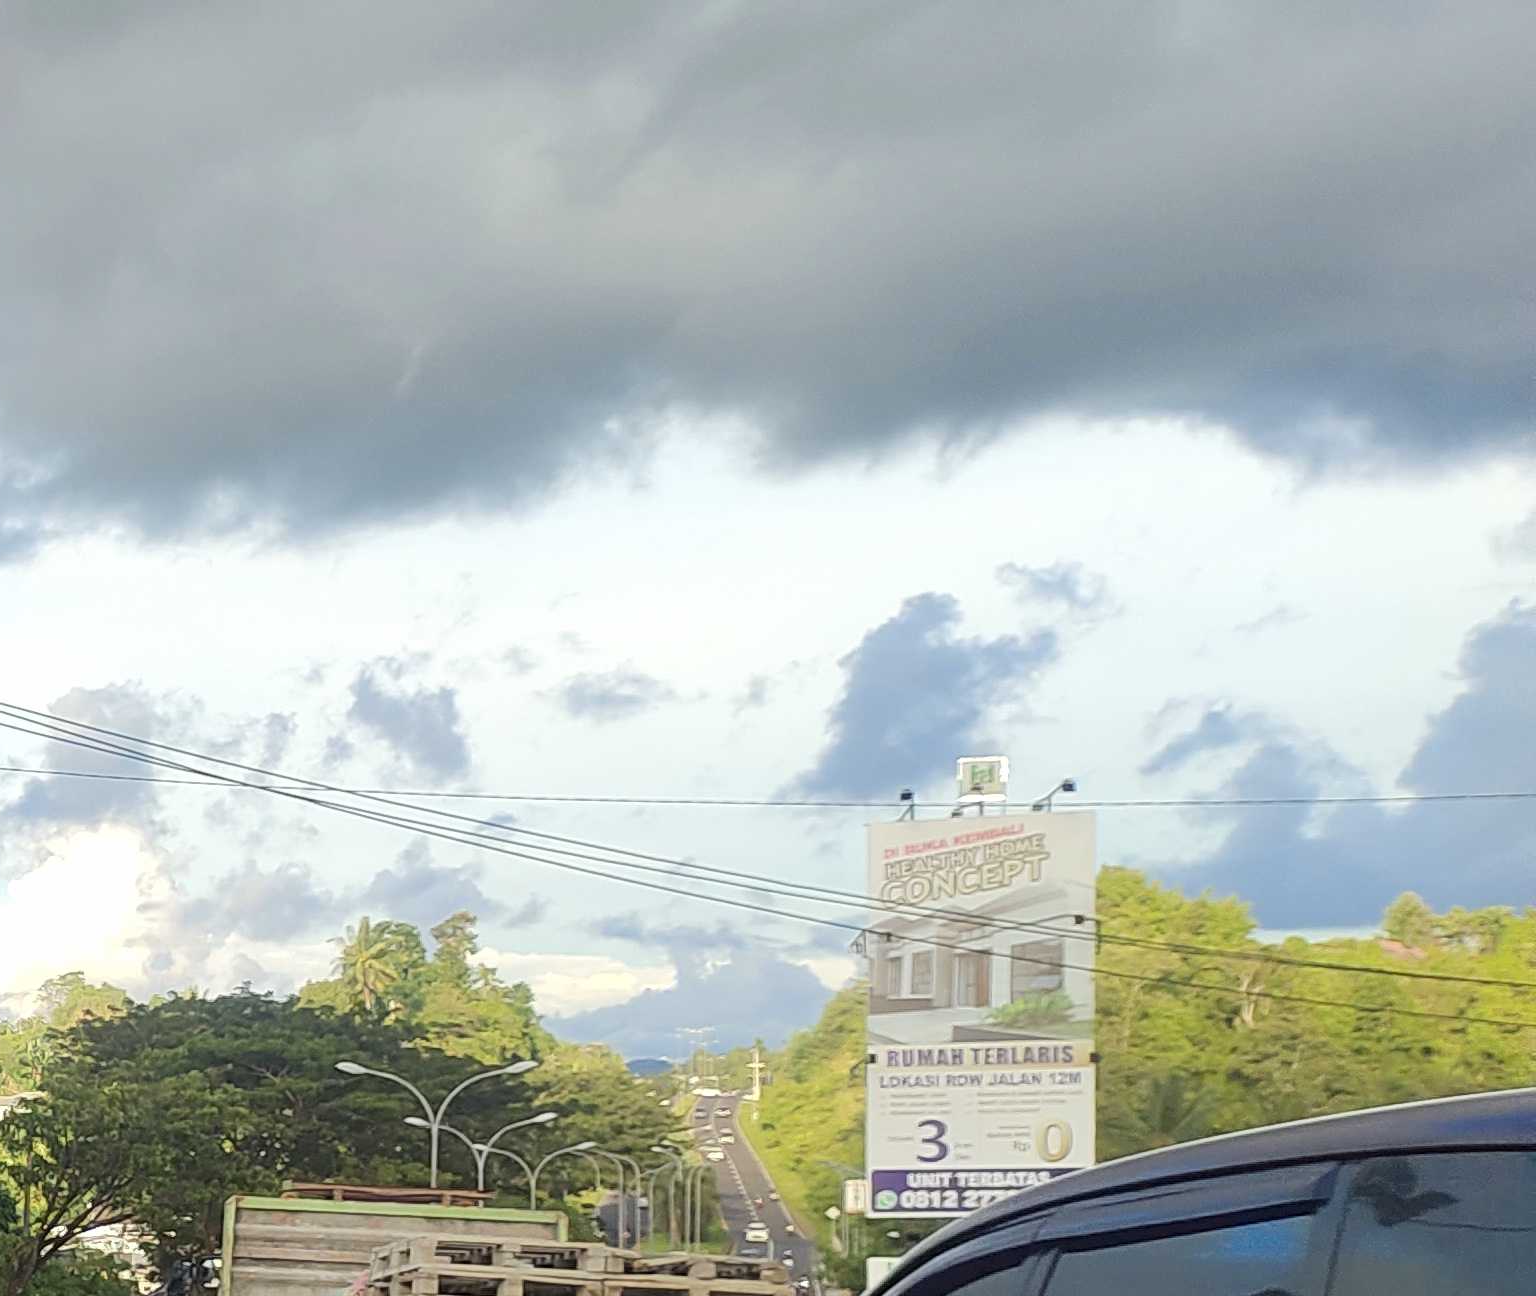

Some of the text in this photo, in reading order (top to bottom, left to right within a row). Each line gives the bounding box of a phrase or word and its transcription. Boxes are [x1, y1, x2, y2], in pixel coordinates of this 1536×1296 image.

[884, 833, 1046, 880] HEALTHY HOME
[881, 852, 1050, 905] CONCEPT
[887, 1045, 1074, 1067] RUMAH TERLARIS
[879, 1072, 1081, 1088] LOKASI ROW JALAN 12M
[916, 1119, 949, 1162] 3
[1036, 1119, 1073, 1163] 0
[906, 1171, 952, 1188] UNIT
[899, 1189, 959, 1209] 0812
